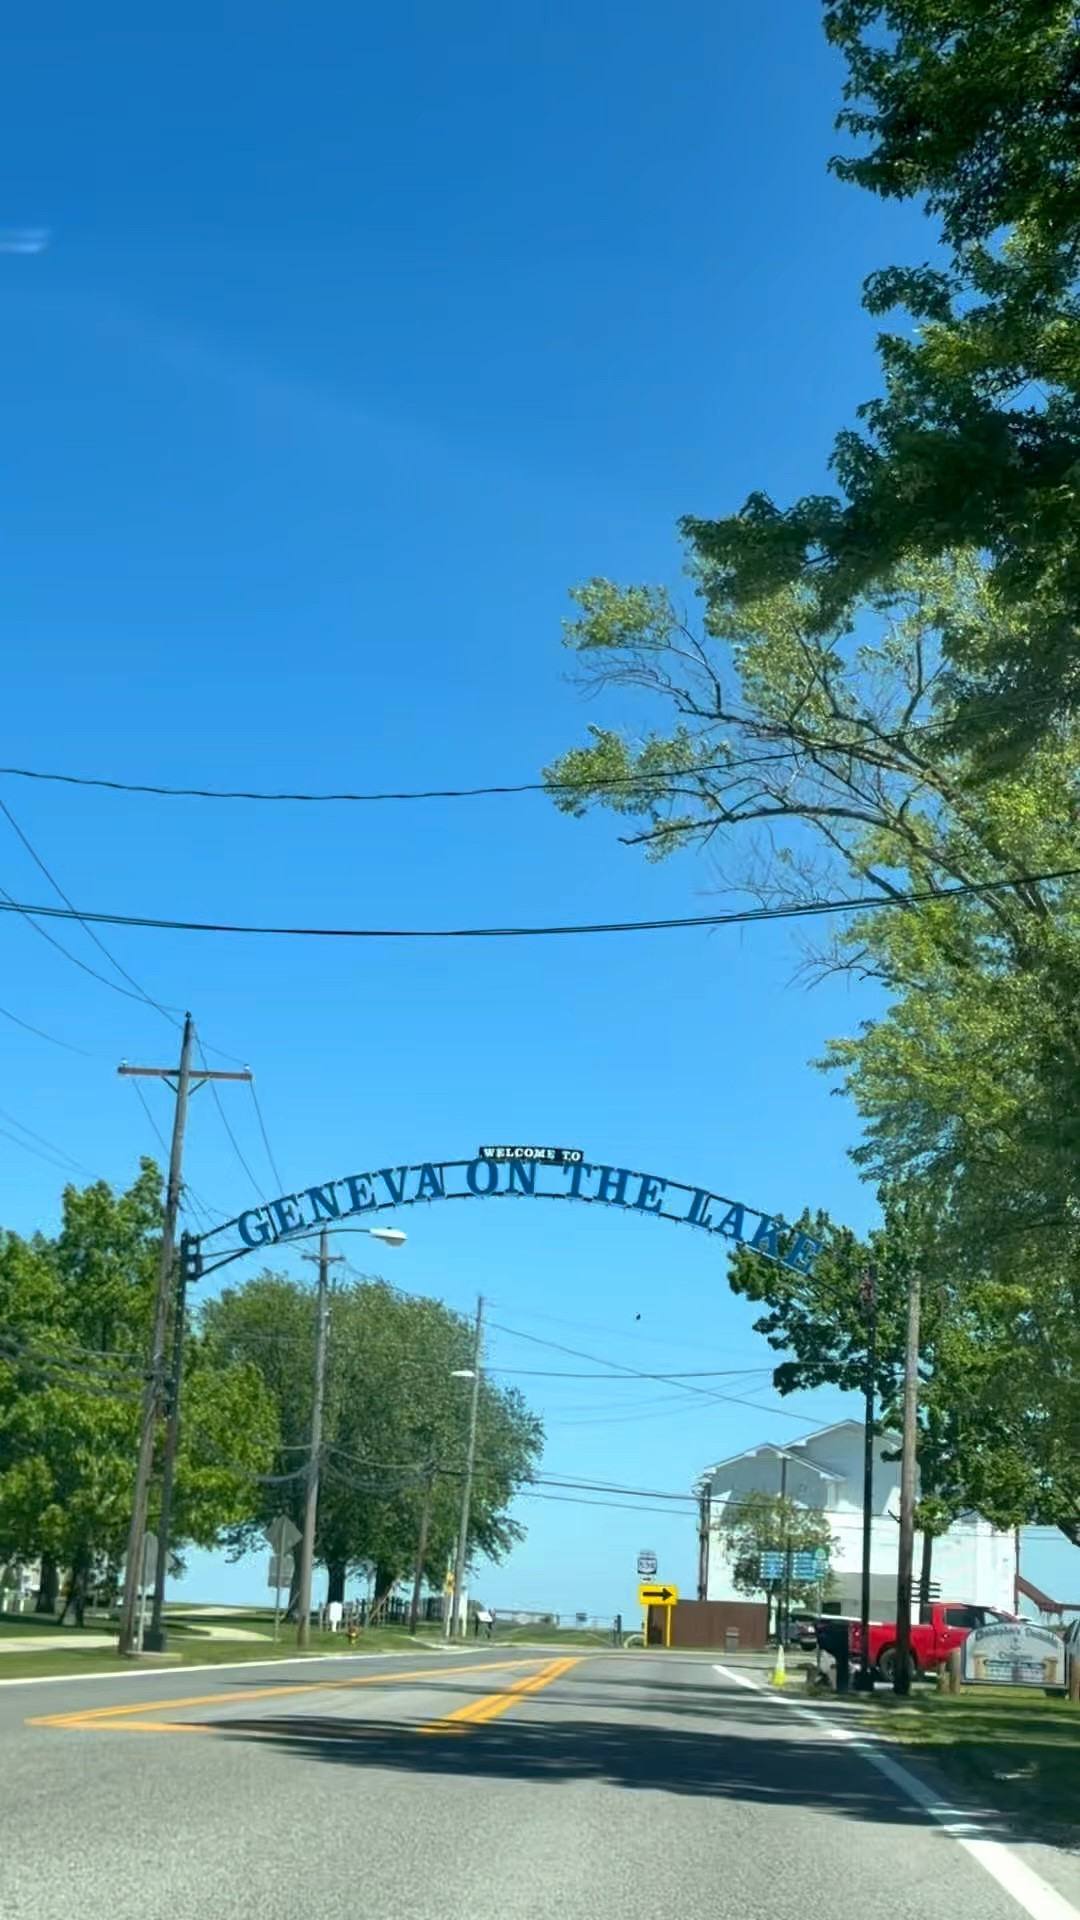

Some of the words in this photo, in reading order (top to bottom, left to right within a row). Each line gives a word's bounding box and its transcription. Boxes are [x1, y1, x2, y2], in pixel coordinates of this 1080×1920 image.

[483, 1148, 555, 1159] WELCOME
[562, 1150, 581, 1161] TO
[238, 1162, 446, 1247] GENEVA
[466, 1158, 537, 1195] ON
[563, 1161, 670, 1213] THE
[682, 1187, 825, 1274] LAKE
